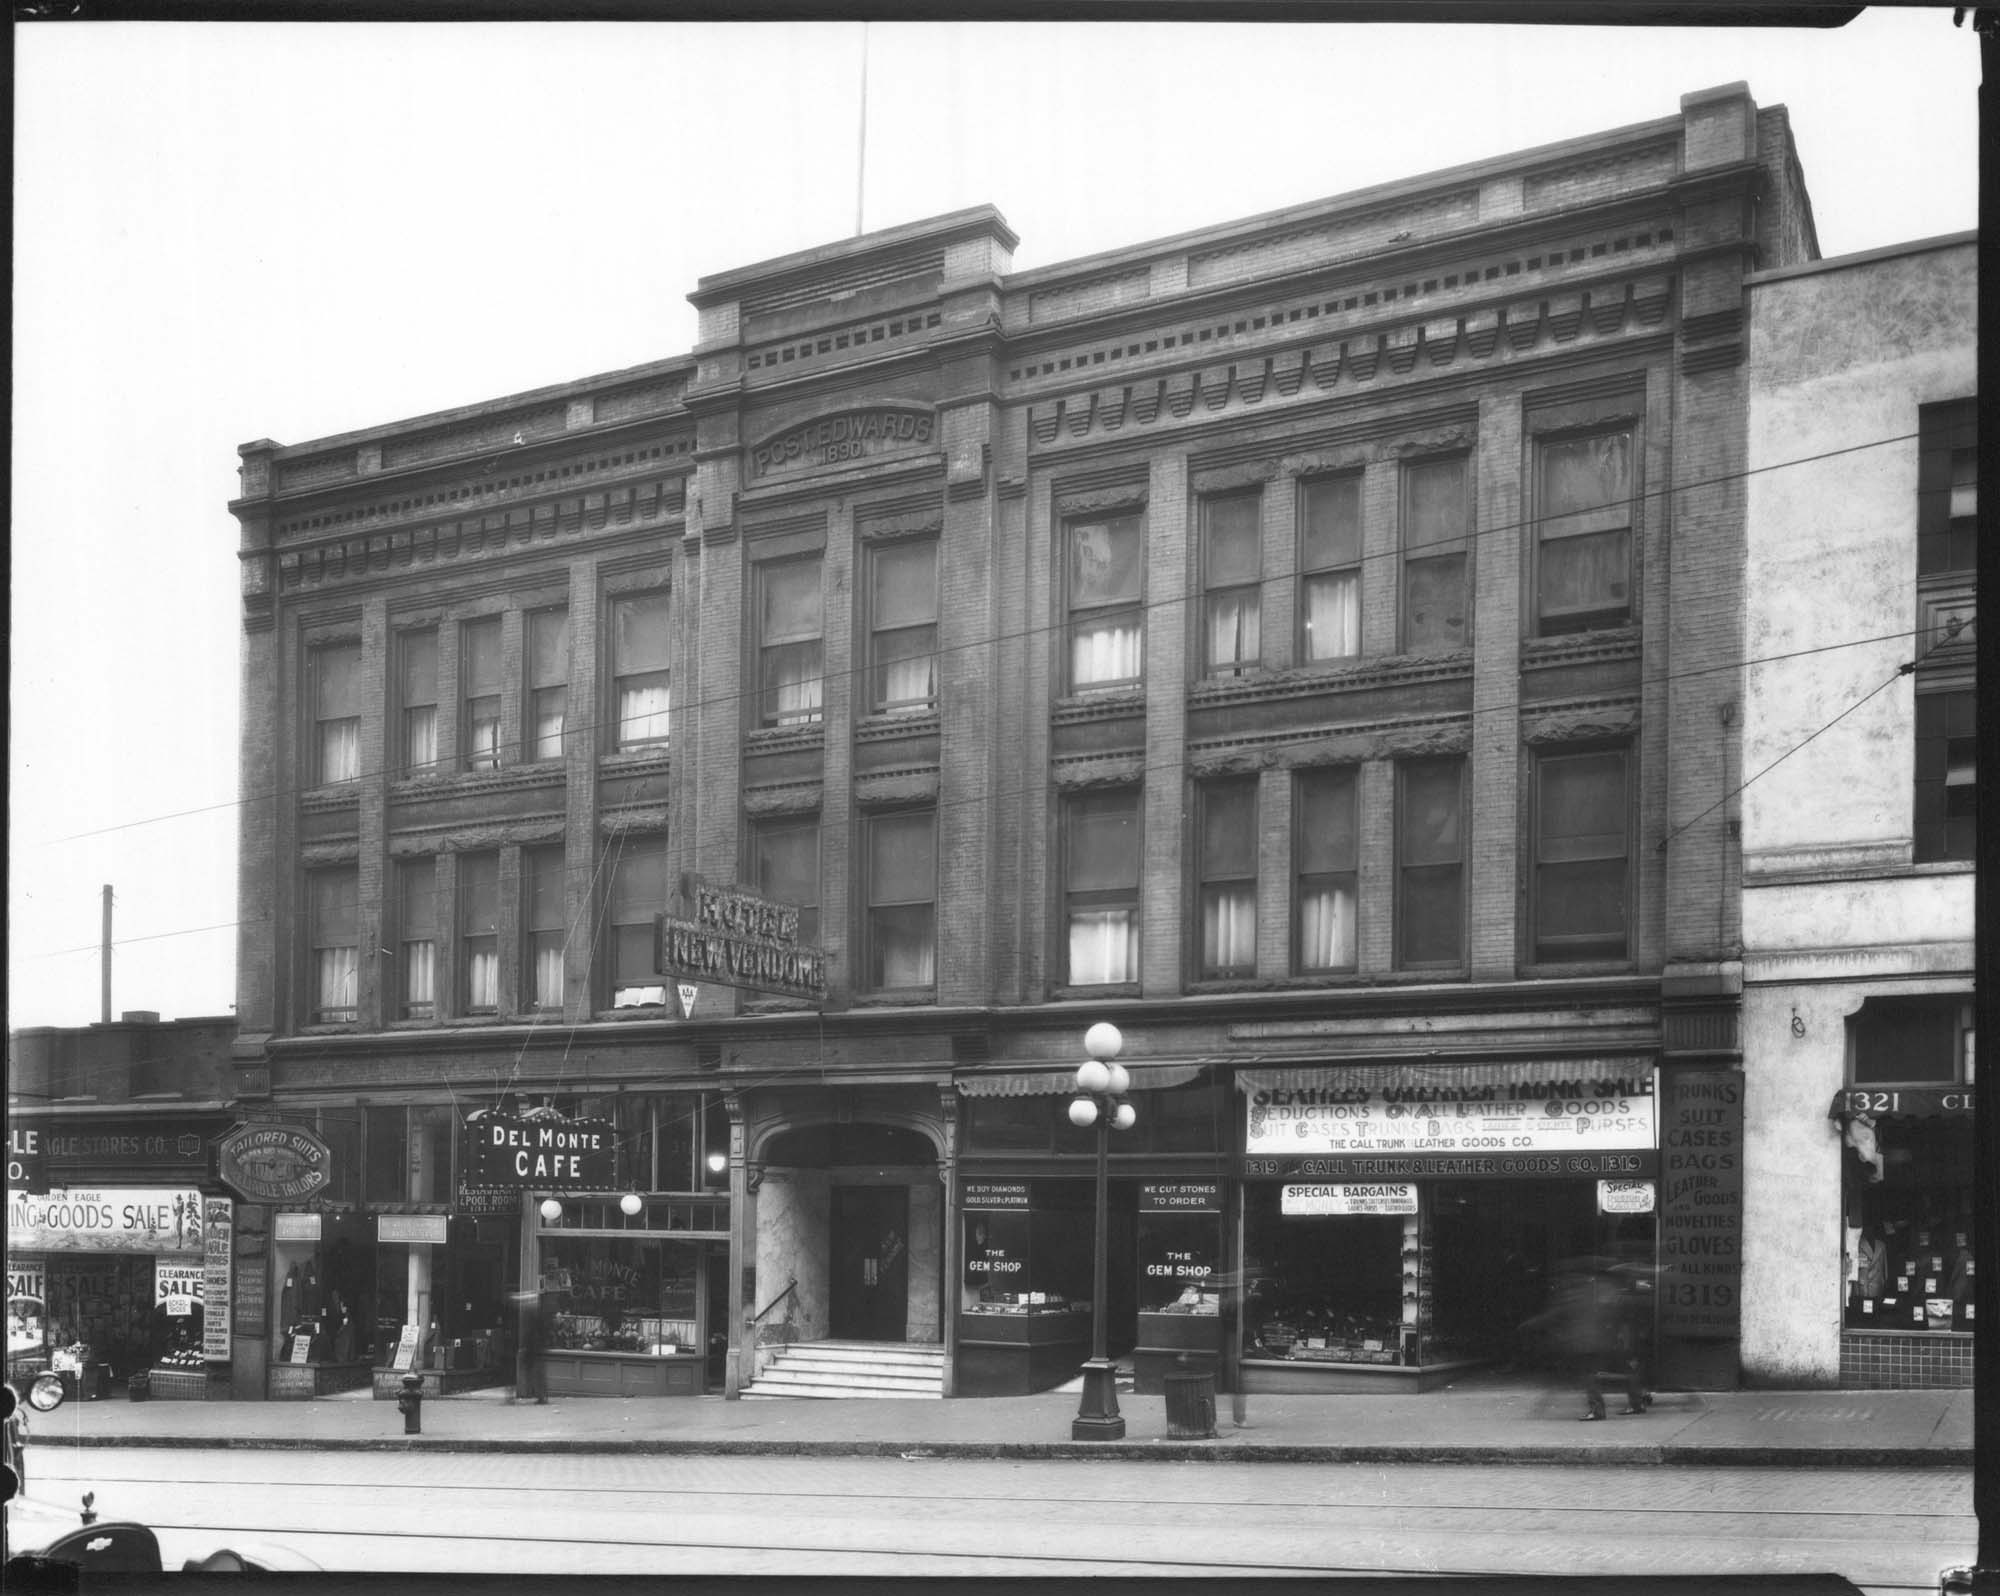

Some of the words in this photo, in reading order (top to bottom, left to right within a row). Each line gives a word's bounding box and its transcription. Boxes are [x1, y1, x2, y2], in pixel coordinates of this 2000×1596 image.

[756, 428, 814, 475] POST
[818, 413, 932, 446] EDWARDS
[1671, 1083, 1737, 1104] TRUNKS
[1844, 1091, 1899, 1112] 1321
[1250, 1104, 1371, 1122] REDUCTIONS
[1456, 1102, 1528, 1118] LEATHER
[1544, 1099, 1631, 1117] GOODS
[1680, 1109, 1727, 1124] SUIT
[1576, 1116, 1650, 1135] PURSES
[8, 1130, 39, 1155] LE
[82, 1135, 139, 1155] STORES
[493, 1126, 531, 1147] DEL
[539, 1128, 600, 1149] MONTE
[1329, 1139, 1346, 1150] THE
[1350, 1139, 1374, 1150] CALL
[1377, 1138, 1406, 1149] TRUNK
[1414, 1138, 1456, 1149] LEATHER
[1462, 1137, 1505, 1148] GOODS
[1668, 1129, 1731, 1147] CASES
[230, 1131, 288, 1157] TAILORED
[289, 1135, 323, 1163] SUITS
[515, 1150, 581, 1178] CAFE
[1247, 1159, 1278, 1175] 1319
[1303, 1159, 1346, 1175] CALL
[1352, 1159, 1409, 1175] TRUNK
[1425, 1158, 1495, 1175] LEATHER
[1502, 1157, 1560, 1174] GOODS
[1567, 1157, 1599, 1173] CO.
[1601, 1154, 1641, 1171] 1319
[1669, 1153, 1736, 1170] BAGS
[280, 1170, 323, 1197] TAILORS
[1144, 1185, 1157, 1193] WE
[1159, 1185, 1178, 1193] CUT
[1179, 1185, 1216, 1193] STONES
[1287, 1186, 1338, 1198] SPECIAL
[1343, 1185, 1408, 1198] BARGAINS
[75, 1192, 101, 1202] EAGLE
[465, 1195, 488, 1207] POOL
[1153, 1197, 1167, 1205] TO
[1168, 1197, 1206, 1205] ORDER
[1693, 1190, 1737, 1206] GOODS
[47, 1203, 113, 1230] GOODS
[122, 1204, 169, 1230] SALE
[1665, 1215, 1736, 1229] NOVELTIES
[986, 1249, 1004, 1257] THE
[1666, 1236, 1735, 1256] GLOVES
[1167, 1252, 1191, 1260] THE
[158, 1268, 204, 1280] CLEARANCE
[969, 1261, 990, 1271] GEM
[994, 1261, 1022, 1272] SHOP
[1147, 1265, 1173, 1276] GEM
[1176, 1265, 1212, 1277] SHOP
[1680, 1263, 1701, 1273] ALL
[8, 1274, 43, 1300] SALE
[158, 1280, 204, 1299] SALE
[1668, 1283, 1734, 1307] 1319
